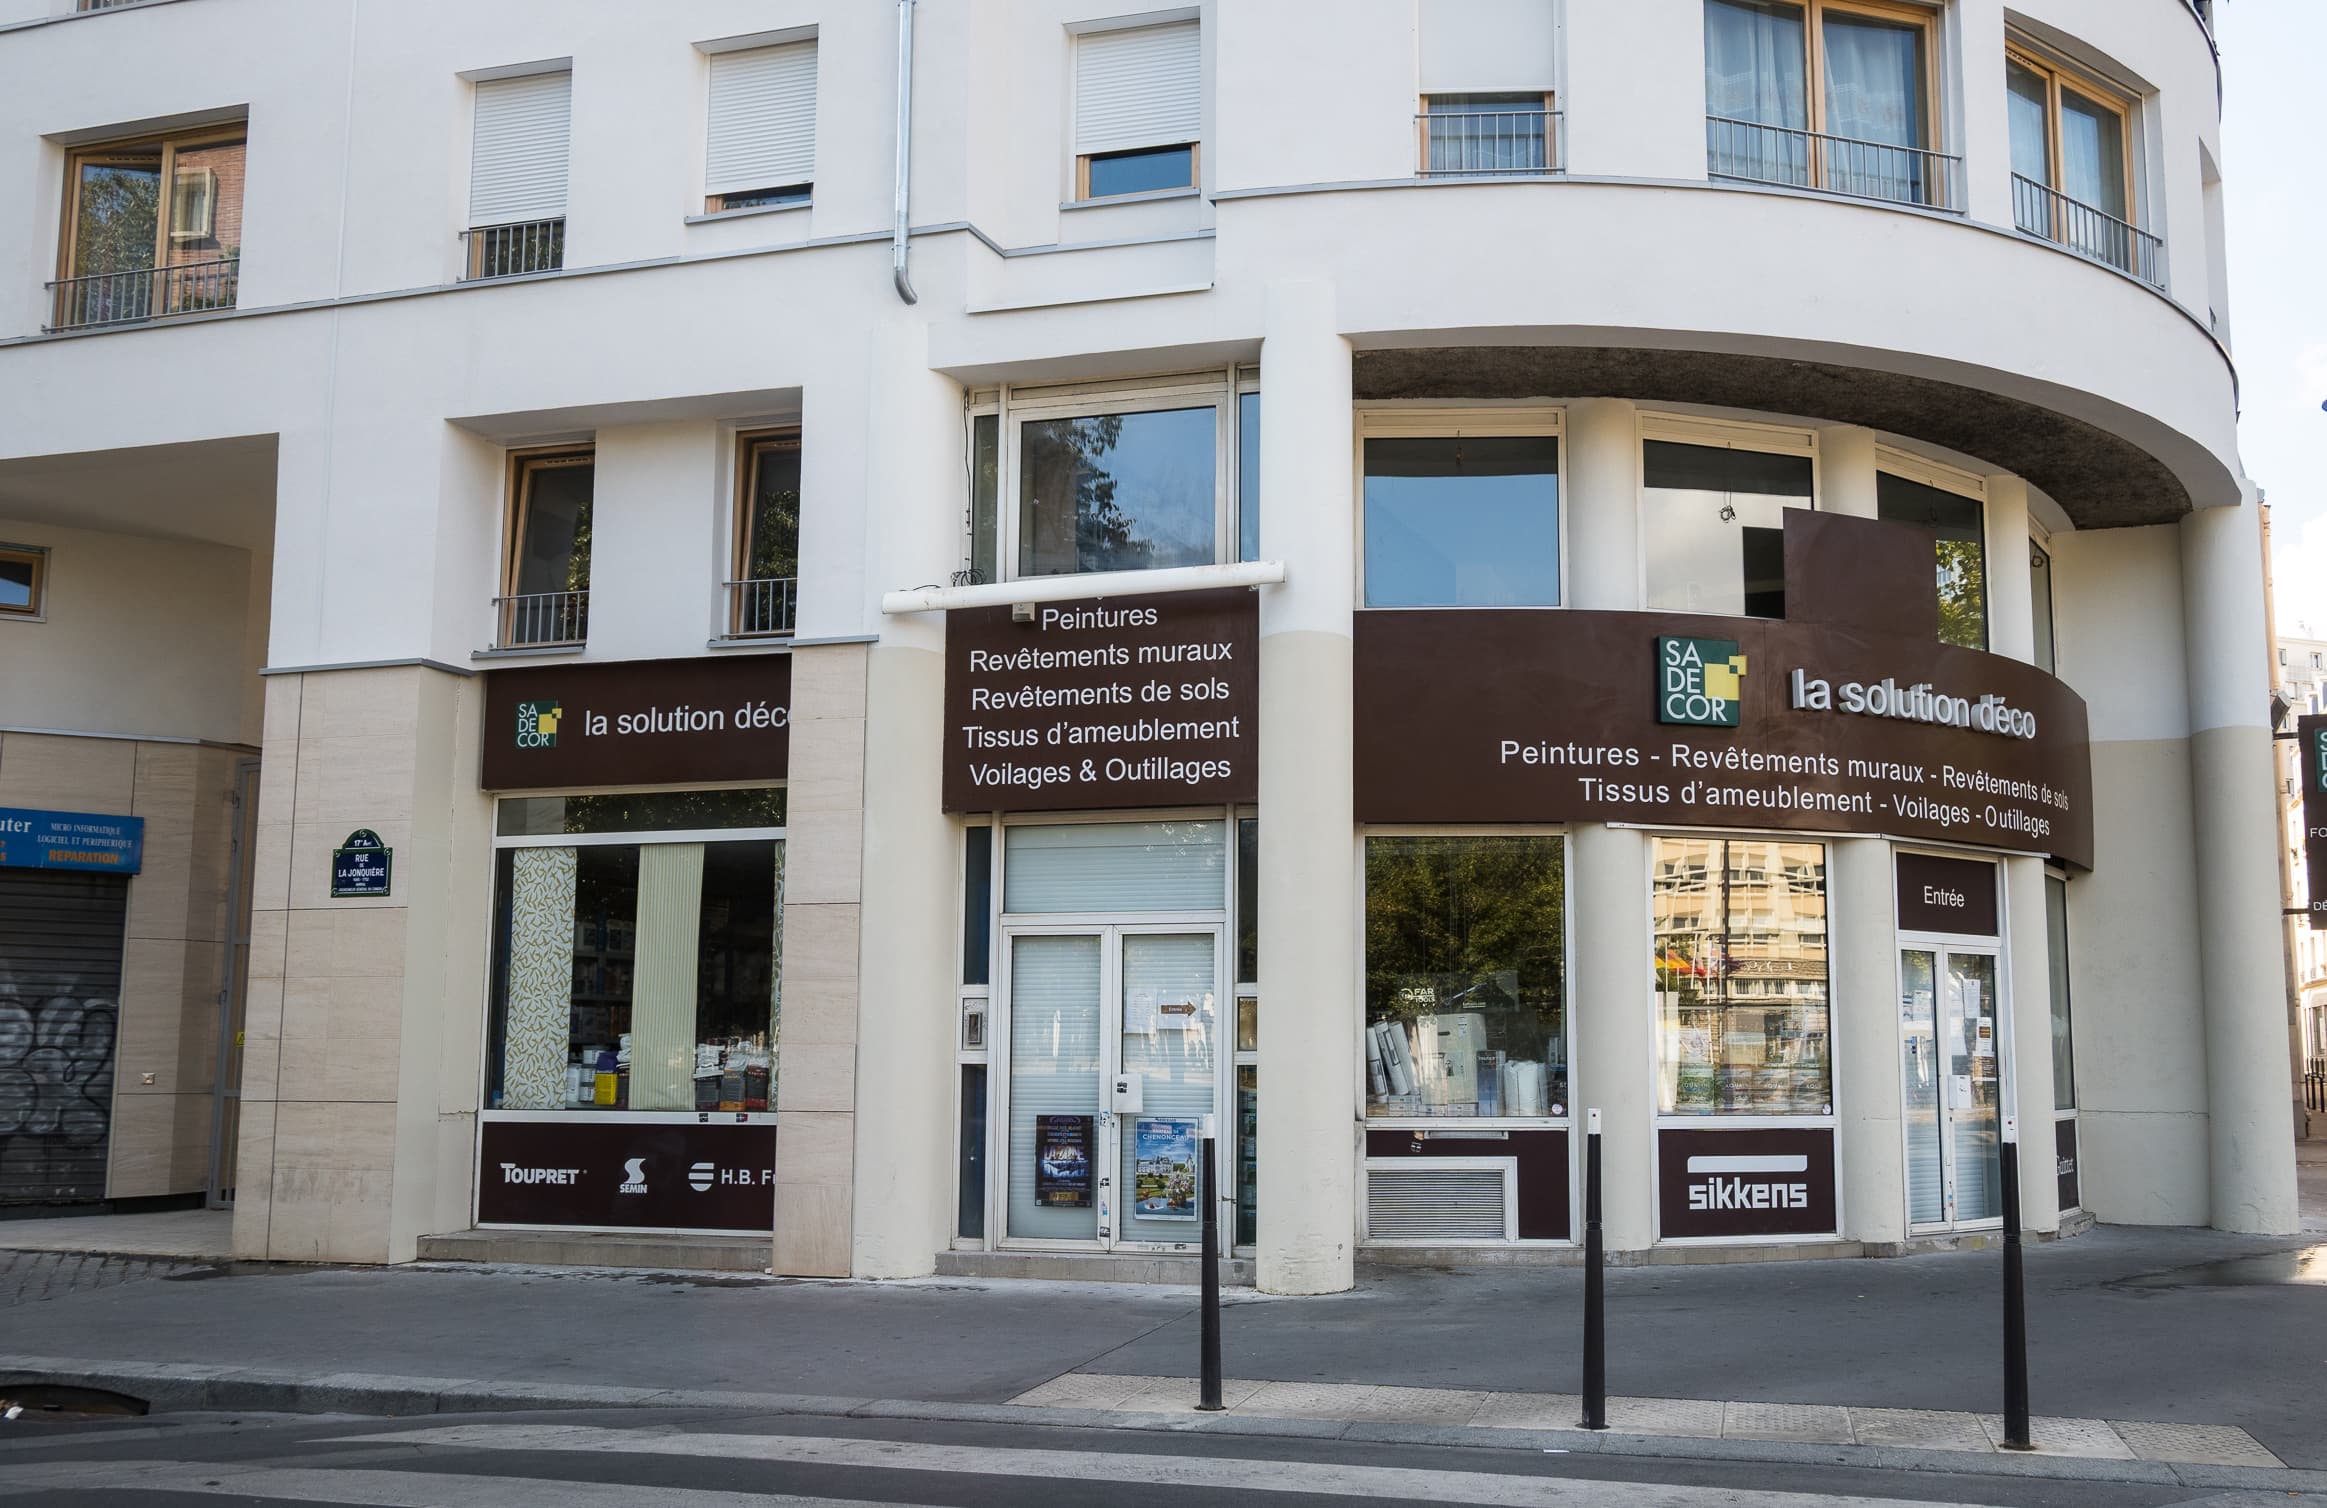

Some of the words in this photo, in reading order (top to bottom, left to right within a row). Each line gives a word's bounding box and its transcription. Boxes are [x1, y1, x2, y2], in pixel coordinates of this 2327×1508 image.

[1042, 606, 1158, 631] Peintures
[970, 643, 1129, 672] Revêtements
[1138, 641, 1233, 664] muraux
[1665, 640, 1703, 667] SA
[1666, 667, 1701, 694] DE
[971, 681, 1133, 710] Revêtements
[1141, 680, 1172, 703] de
[1180, 677, 1229, 700] sols
[1791, 668, 1832, 711] la
[1838, 678, 1970, 728] solution
[1970, 693, 2036, 740] déco
[518, 703, 538, 718] SA
[1666, 694, 1728, 722] COR
[518, 718, 536, 733] DE
[585, 710, 607, 736] la
[617, 705, 724, 734] solution
[962, 726, 1039, 749] Tissus
[1047, 715, 1240, 745] d'ameublement
[517, 733, 550, 748] COR
[970, 761, 1071, 790] Voilages
[1079, 759, 1097, 782] &
[1105, 756, 1232, 784] Outillages
[1501, 740, 1640, 766] Peintures
[1672, 744, 1839, 776] Revêtements
[1848, 758, 1924, 783] muraux
[1943, 765, 2038, 802] Revêtements
[2041, 783, 2052, 805] de
[2054, 788, 2069, 811] sols
[1578, 778, 1670, 803] Tissus
[1681, 780, 1873, 814] d'ameublement
[1893, 794, 1970, 827] Voilages
[1985, 805, 2050, 838] Outillages
[37, 834, 69, 845] LOGICIEL
[71, 837, 80, 845] ET
[51, 823, 72, 831] MICRO
[73, 824, 121, 837] INFORMATIQUE
[49, 849, 119, 864] REPARATION
[355, 854, 369, 862] RUE
[338, 869, 347, 878] LA
[1924, 885, 1965, 908] Entrée
[1414, 987, 1434, 995] FAR
[500, 1162, 579, 1185] TOUPRET
[721, 1169, 756, 1185] H.B.
[762, 1169, 776, 1185] F
[619, 1184, 648, 1194] SEMIN
[1688, 1176, 1808, 1210] sikkens
